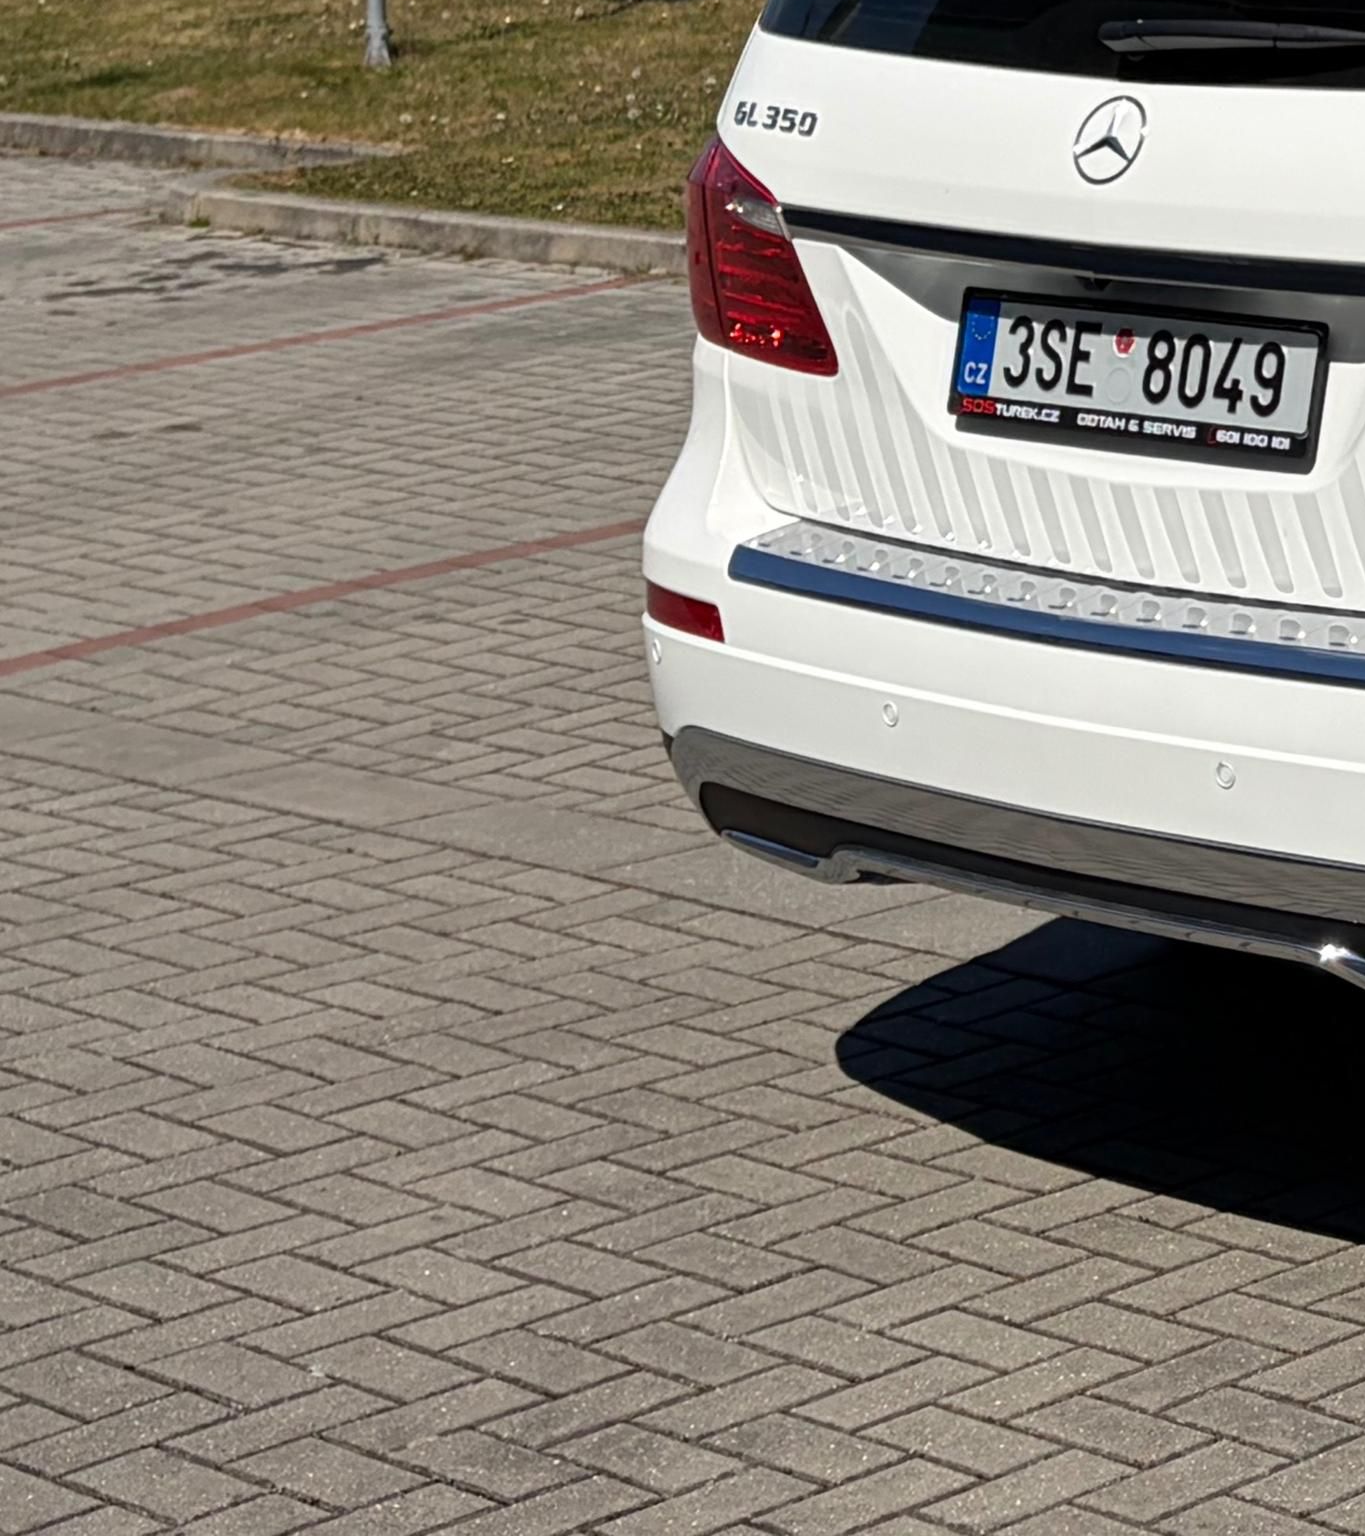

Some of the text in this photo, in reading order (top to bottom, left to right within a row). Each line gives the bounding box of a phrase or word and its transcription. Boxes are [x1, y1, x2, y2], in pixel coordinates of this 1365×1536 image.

[734, 101, 818, 137] GL 350
[963, 361, 987, 386] CZ
[1002, 315, 1287, 418] 3SE 8049
[1077, 413, 1126, 431] ODTAH
[1143, 421, 1196, 440] SERVIS
[1215, 429, 1239, 444] 601
